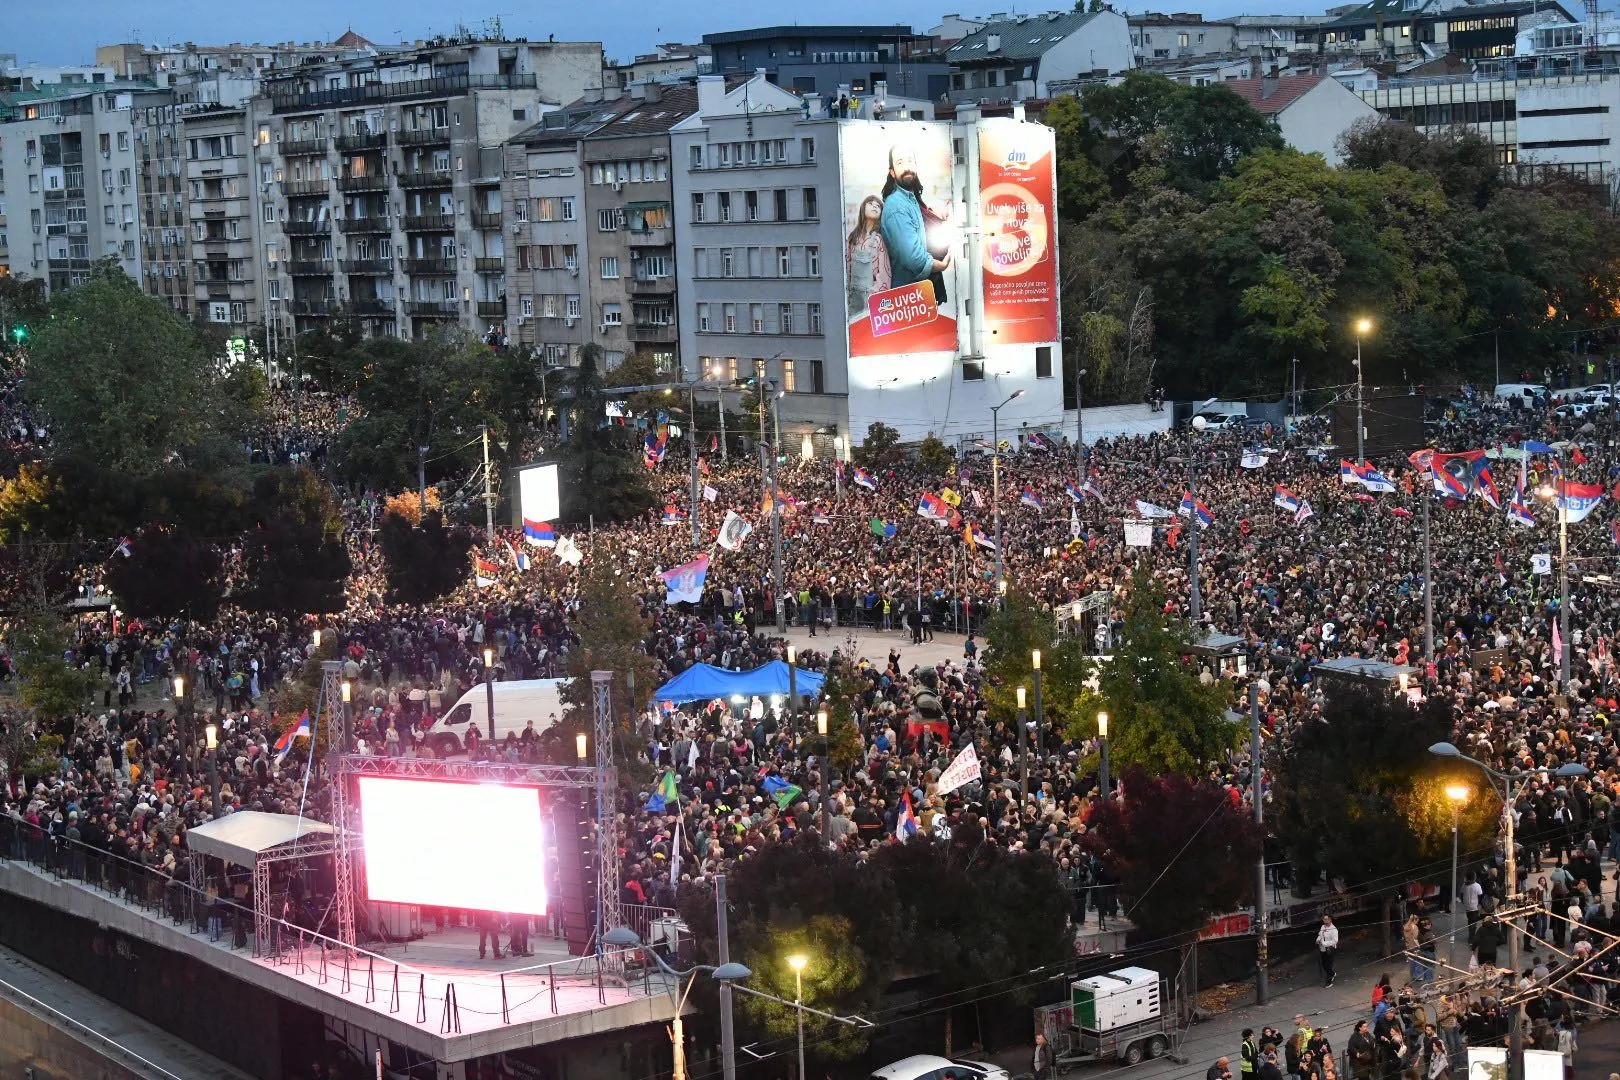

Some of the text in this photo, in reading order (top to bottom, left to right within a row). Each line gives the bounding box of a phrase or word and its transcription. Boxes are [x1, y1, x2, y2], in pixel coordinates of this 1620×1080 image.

[1007, 150, 1026, 162] dm
[1013, 201, 1030, 213] više
[895, 289, 925, 308] uvek
